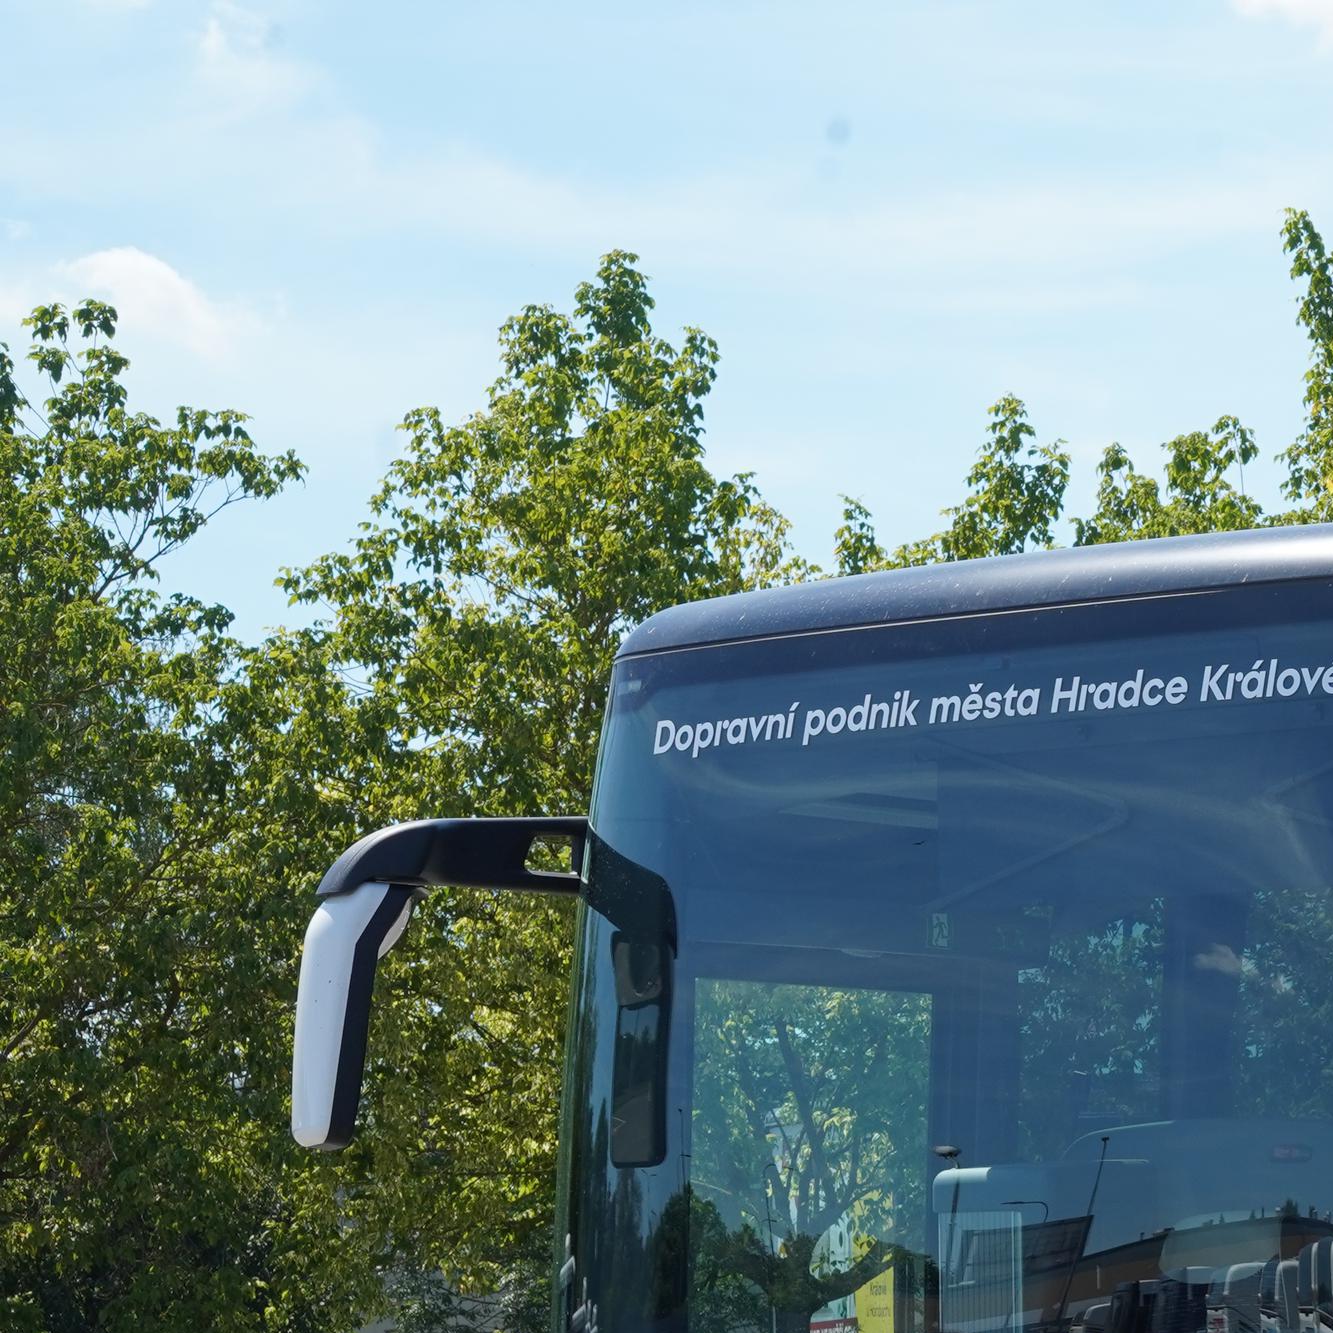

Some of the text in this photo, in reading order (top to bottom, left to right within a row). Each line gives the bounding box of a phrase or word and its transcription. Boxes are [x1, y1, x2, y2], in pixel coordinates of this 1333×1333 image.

[653, 702, 800, 758] Dopravní
[802, 690, 920, 746] podnik
[929, 683, 1040, 724] města
[1050, 669, 1188, 713] Hradce
